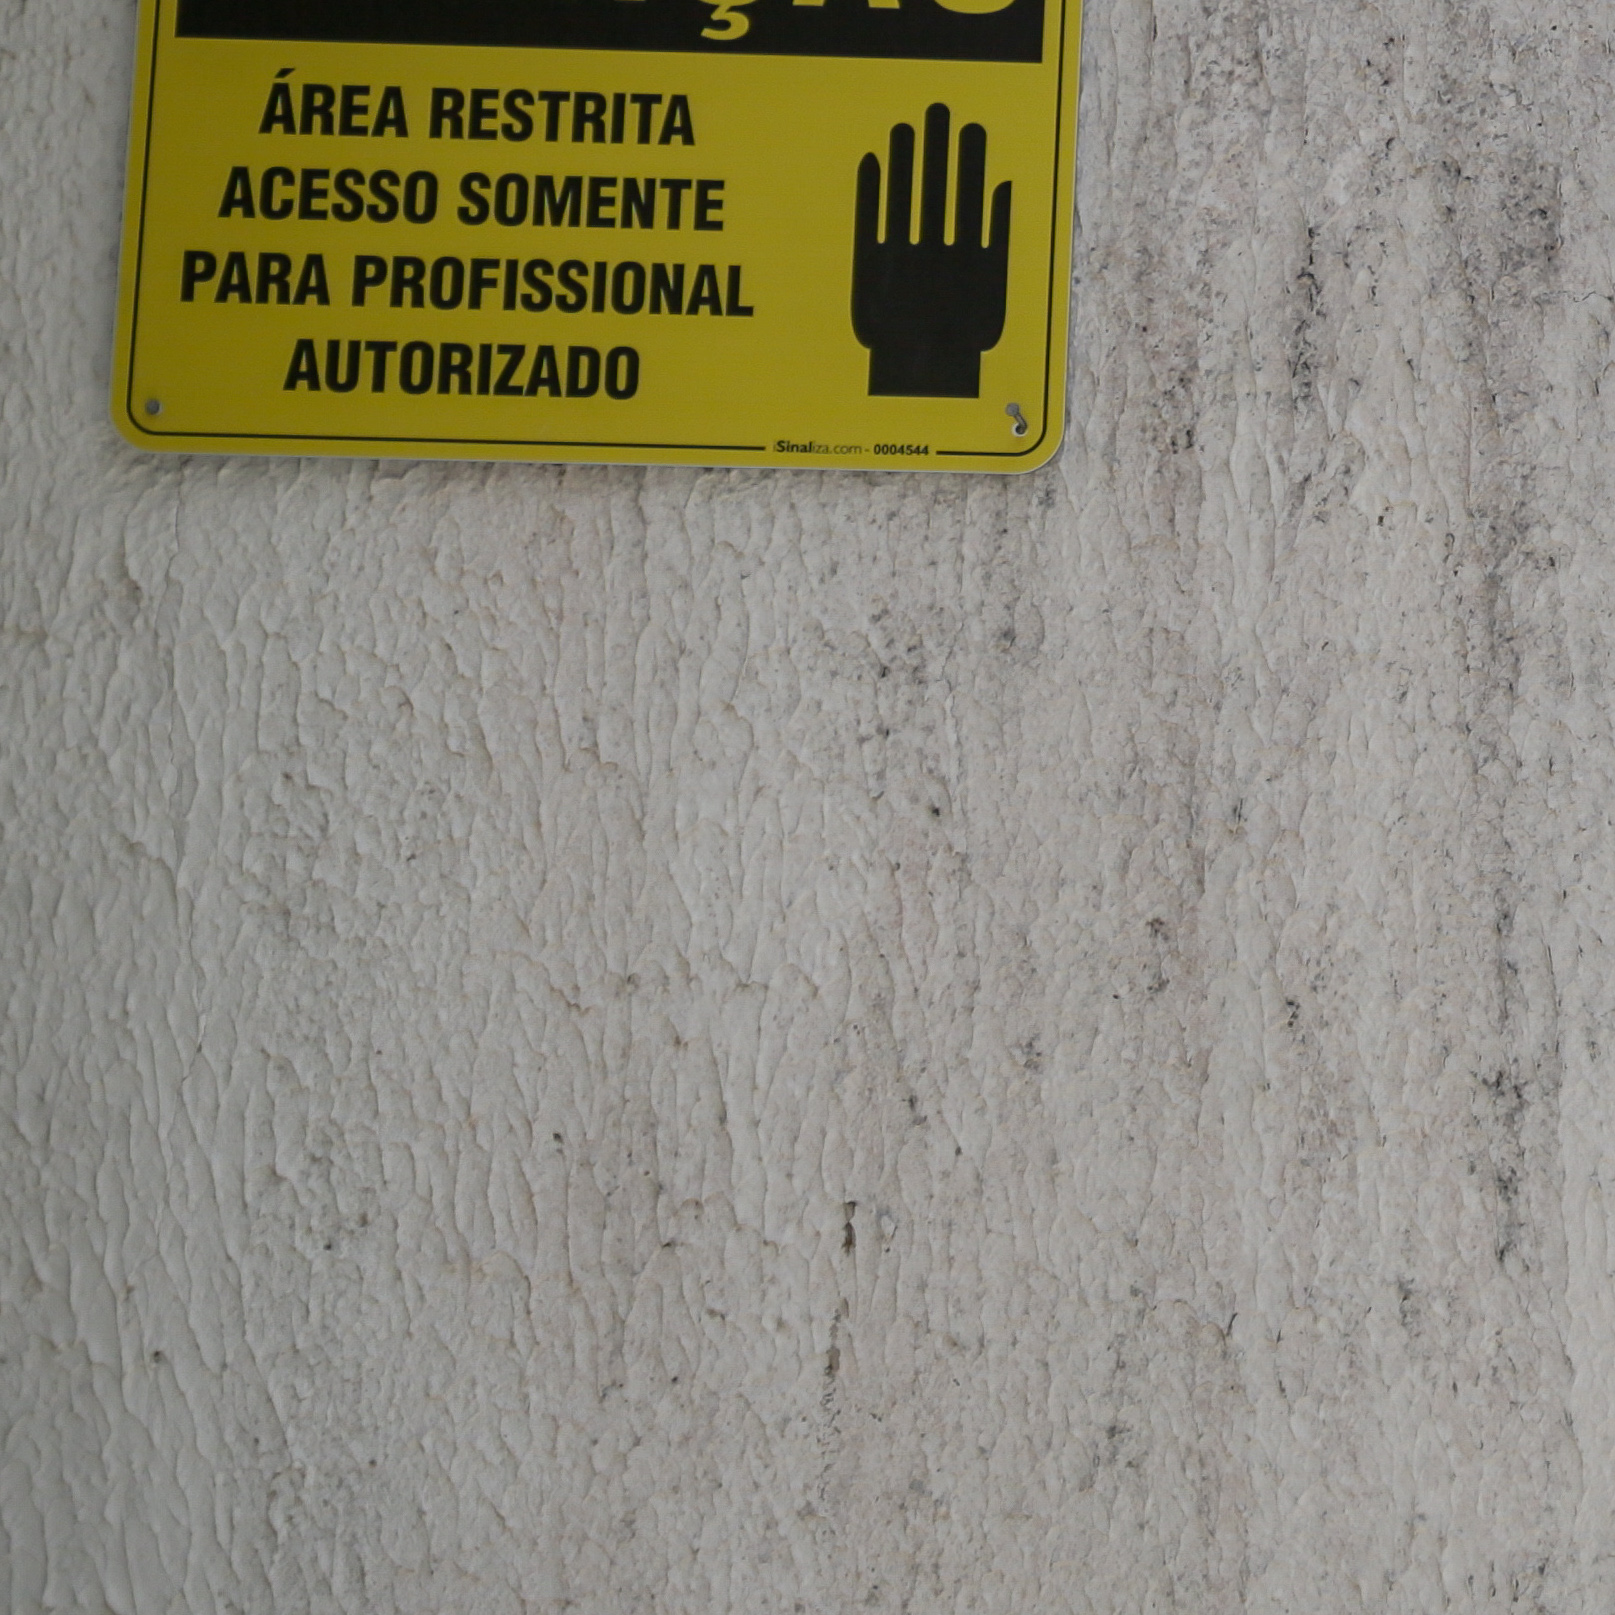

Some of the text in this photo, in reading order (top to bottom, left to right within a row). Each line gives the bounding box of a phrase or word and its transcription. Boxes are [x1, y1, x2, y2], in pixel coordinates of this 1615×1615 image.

[258, 67, 695, 147] ÁREA RESTRITA
[217, 164, 725, 232] ACESSO SOMENTE
[179, 249, 755, 317] PARA PROFISSIONAL
[282, 337, 641, 401] AUTORIZADO
[873, 443, 930, 456] 0004544
